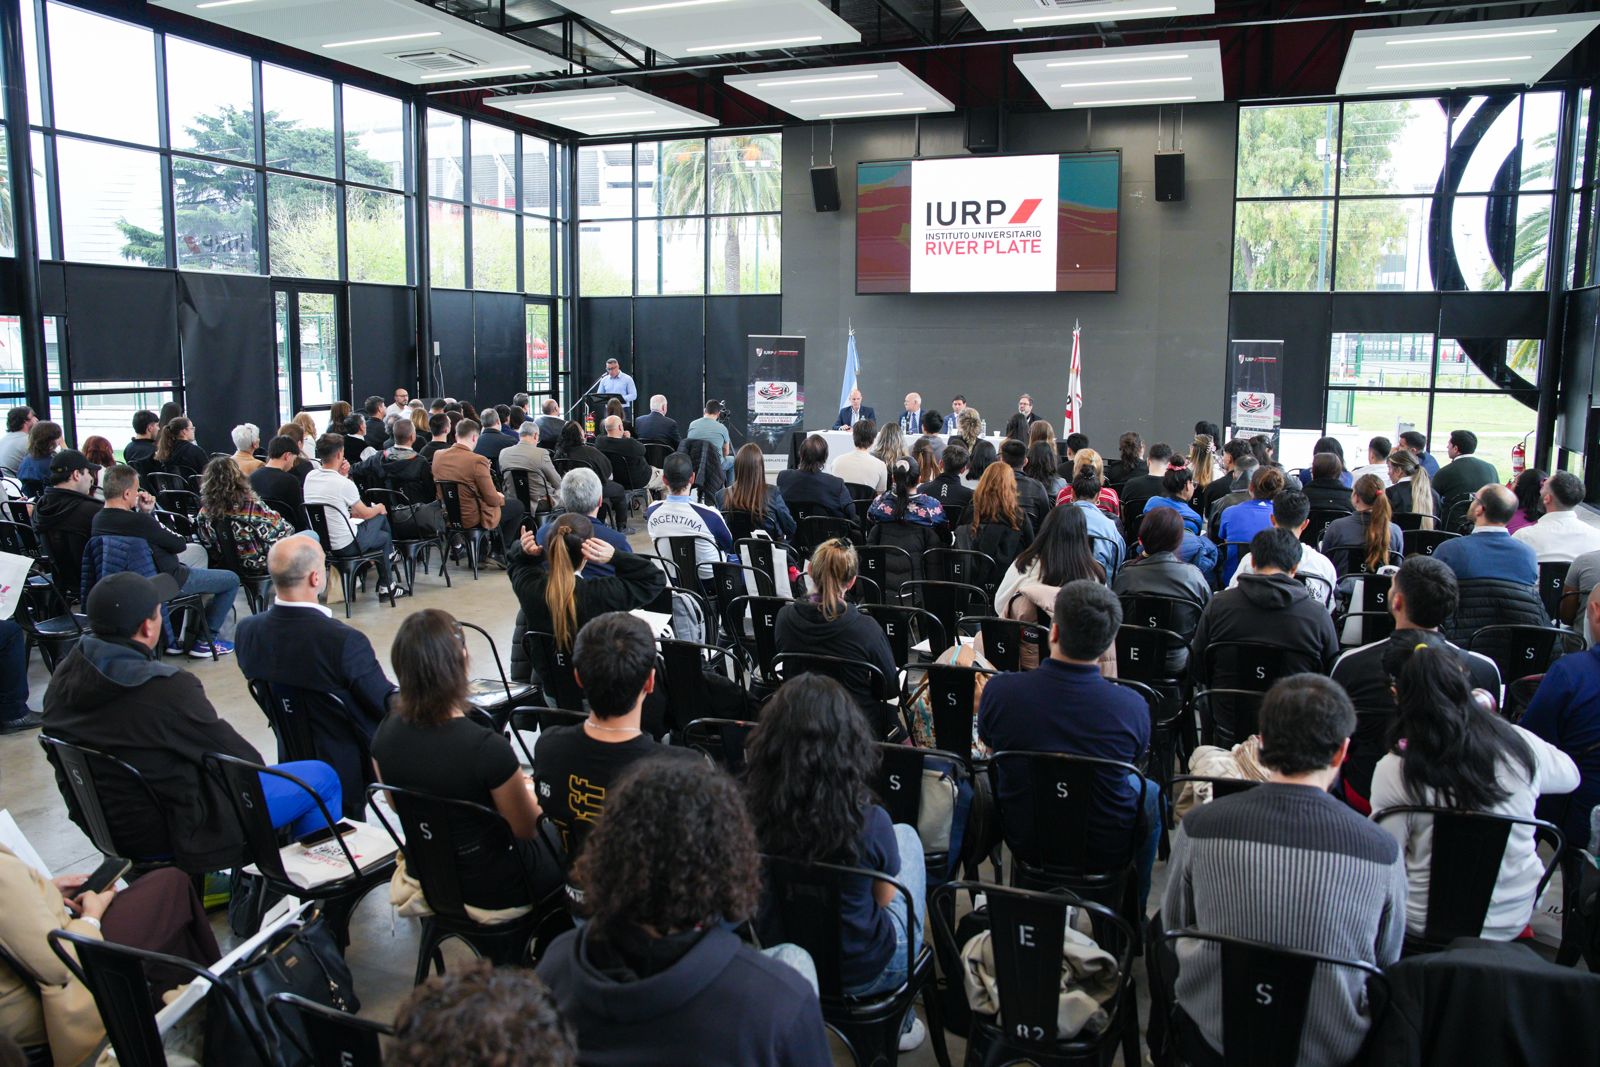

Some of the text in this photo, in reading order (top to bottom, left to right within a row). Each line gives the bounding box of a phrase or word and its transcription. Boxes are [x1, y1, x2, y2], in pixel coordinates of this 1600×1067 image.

[926, 199, 1006, 226] IURP
[925, 230, 1042, 240] INSTITUTO UNIVERSITARIO
[925, 239, 1042, 256] RIVER PLATE
[650, 514, 702, 532] ARGENTINA
[1427, 546, 1433, 554] S
[759, 557, 765, 565] S
[869, 560, 875, 569] E
[955, 564, 960, 573] E
[1361, 564, 1366, 572] S
[726, 580, 732, 590] S
[1553, 579, 1560, 588] S
[1377, 594, 1384, 603] S
[765, 615, 773, 627] E
[1149, 617, 1156, 628] S
[887, 624, 894, 635] E
[998, 642, 1005, 653] S
[1525, 647, 1535, 659] S
[557, 654, 565, 666] E
[1131, 648, 1139, 660] E
[1256, 666, 1265, 679] S
[283, 698, 293, 712] E
[947, 693, 956, 705] S
[73, 769, 83, 784] S
[890, 775, 900, 790] S
[1057, 782, 1068, 798] S
[243, 792, 253, 808] S
[420, 822, 432, 840] S
[1019, 924, 1035, 946] E
[1256, 983, 1272, 1005] S
